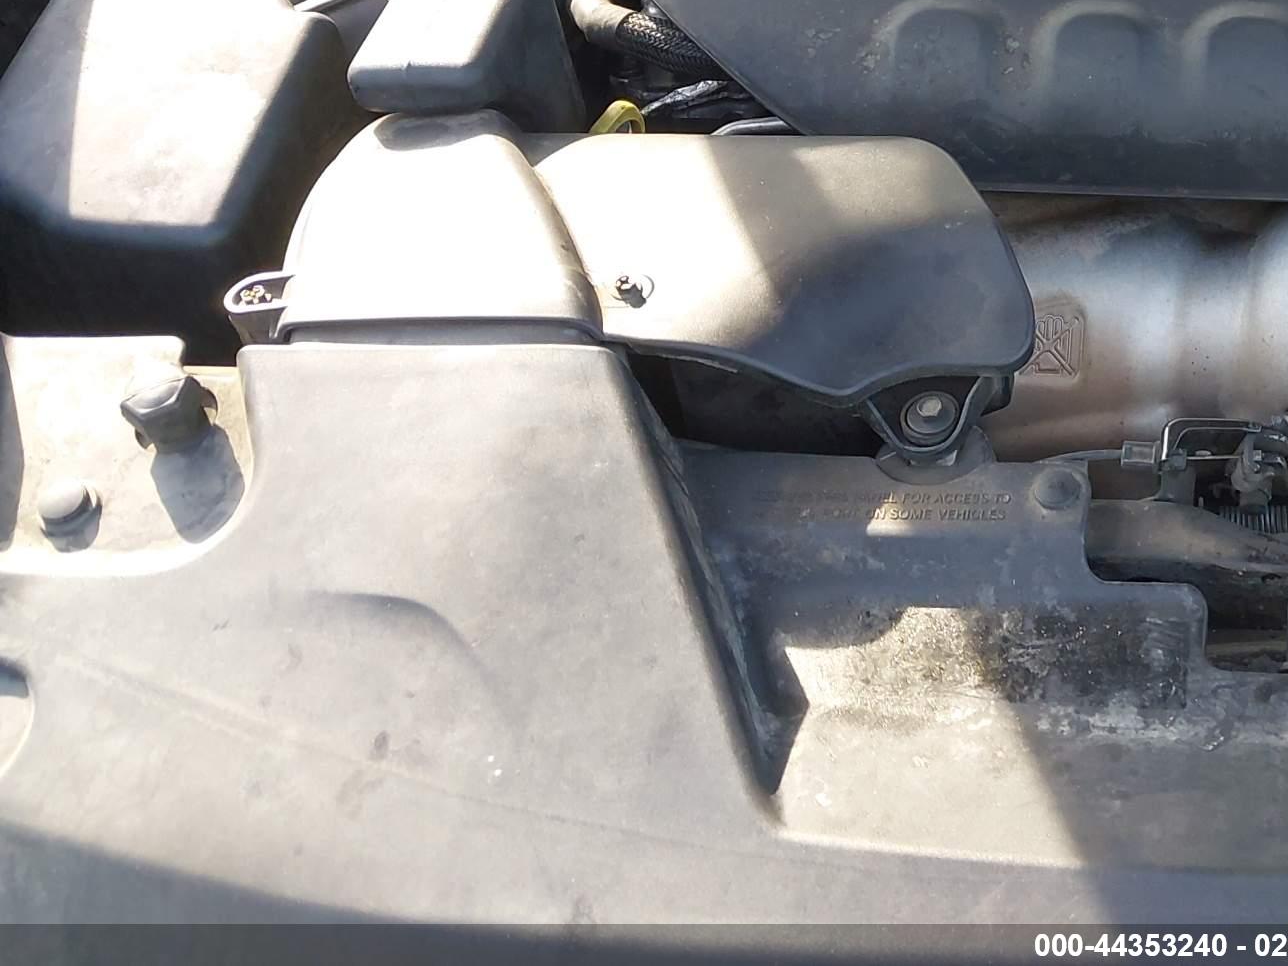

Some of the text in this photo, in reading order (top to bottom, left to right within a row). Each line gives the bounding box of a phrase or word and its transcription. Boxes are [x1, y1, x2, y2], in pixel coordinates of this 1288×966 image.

[901, 492, 931, 505] FOR
[934, 493, 990, 505] ACCESS
[993, 493, 1012, 505] TO
[867, 509, 886, 520] ON
[889, 509, 933, 521] SOME
[938, 509, 1006, 521] VEHICLES
